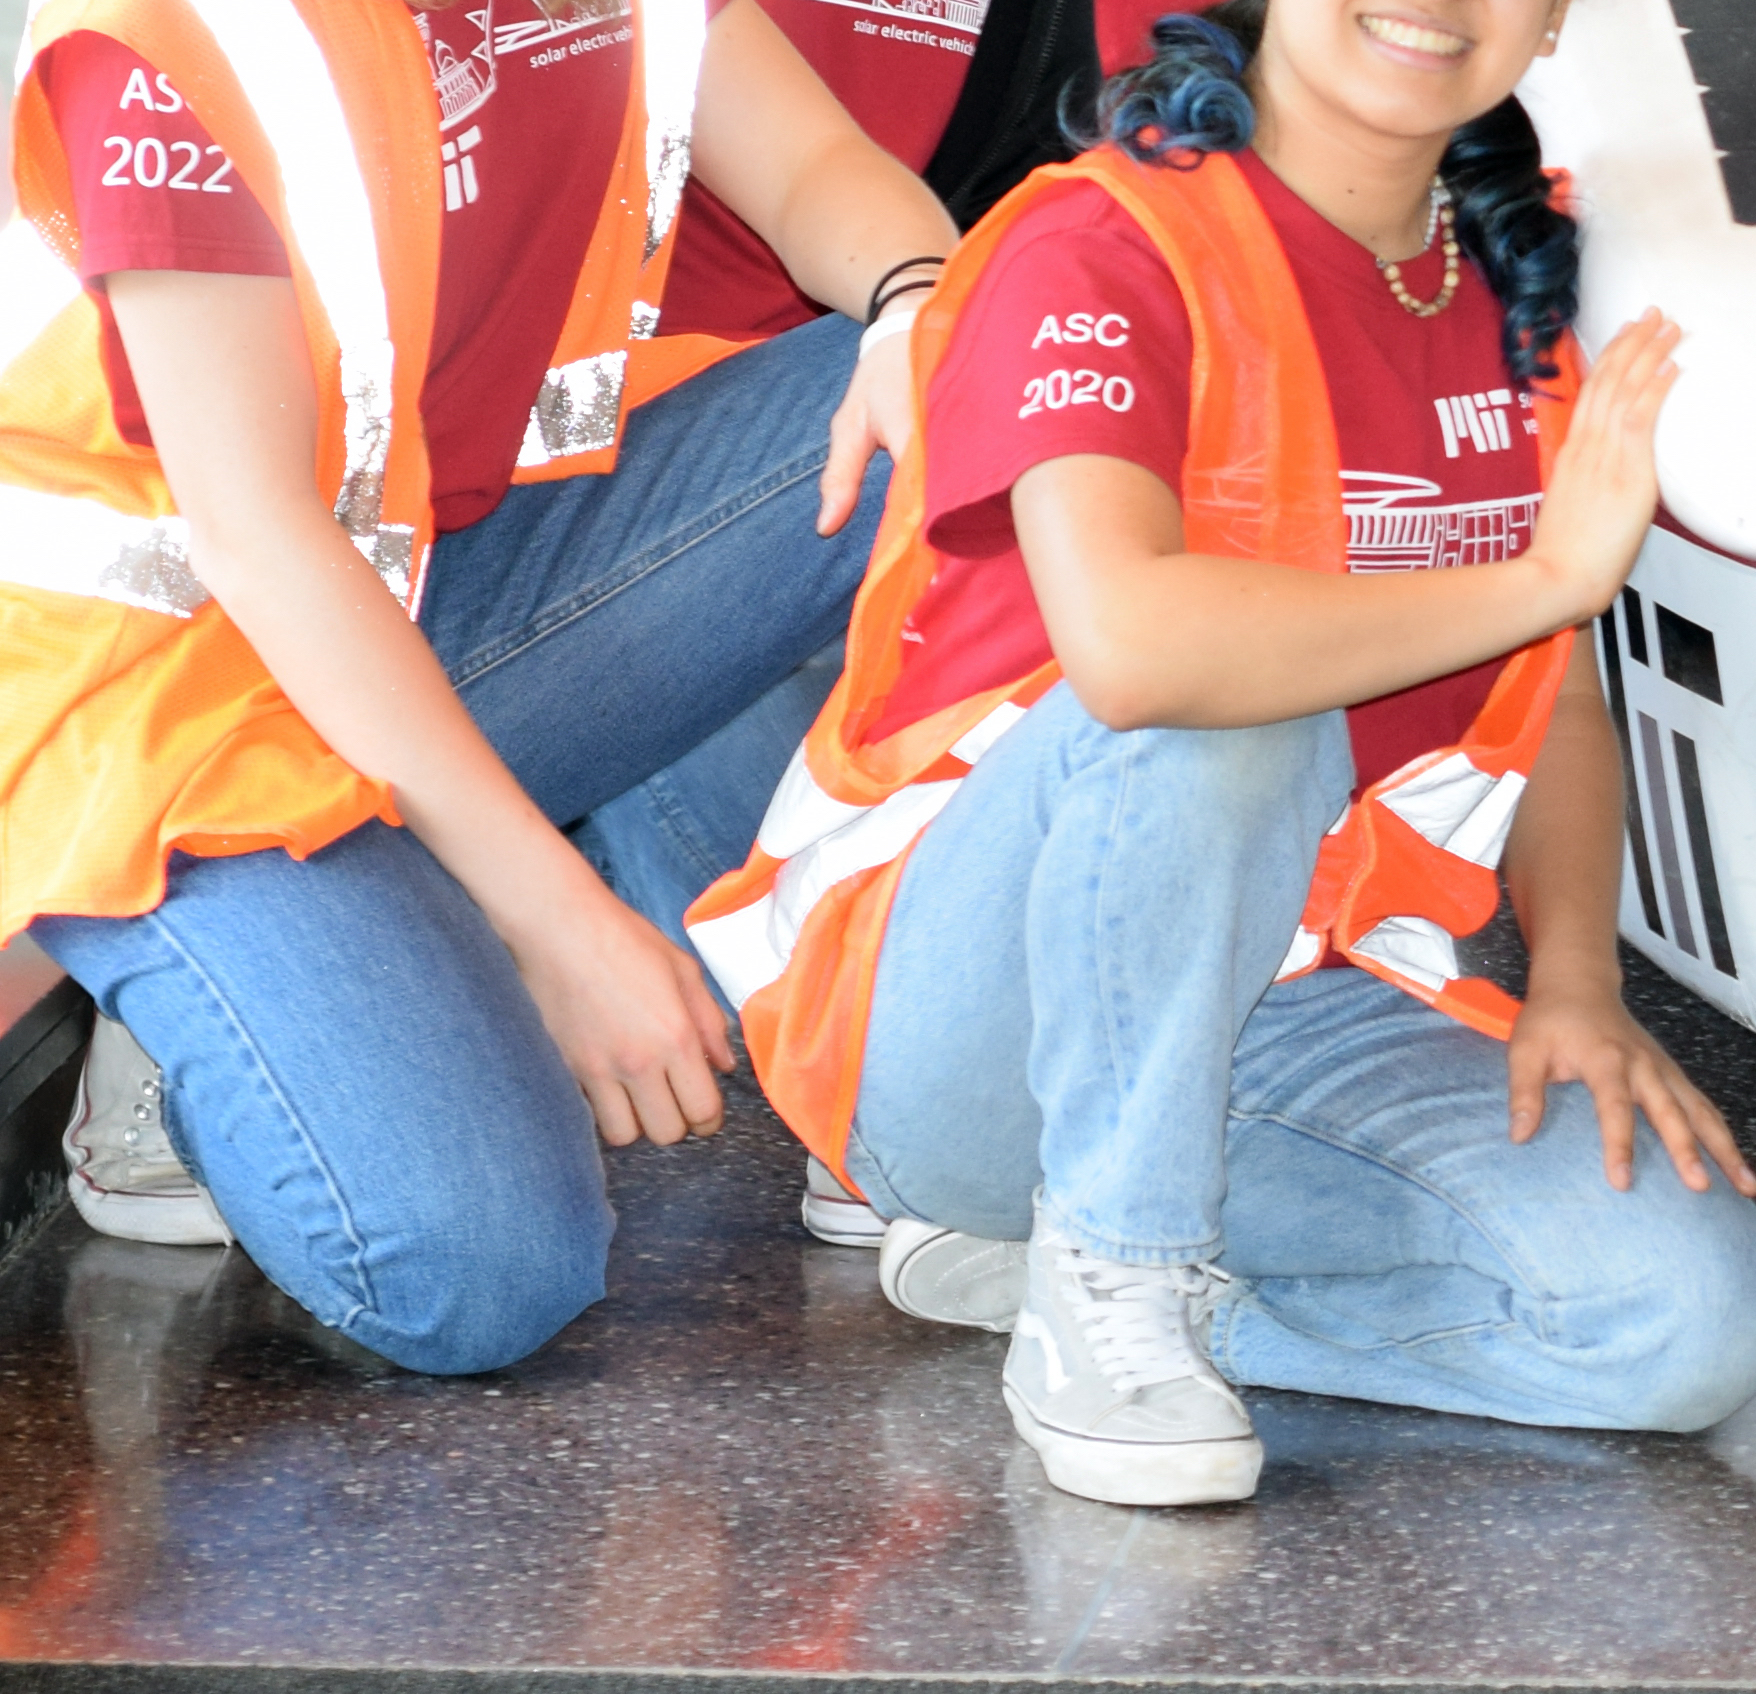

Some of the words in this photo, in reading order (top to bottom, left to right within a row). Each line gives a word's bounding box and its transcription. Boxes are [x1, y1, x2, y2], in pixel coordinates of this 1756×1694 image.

[529, 48, 567, 70] solar
[569, 31, 614, 56] electric
[880, 24, 937, 48] electric
[119, 67, 190, 114] AS
[101, 135, 233, 194] 2022
[1031, 312, 1131, 350] ASC
[1018, 369, 1136, 420] 2020
